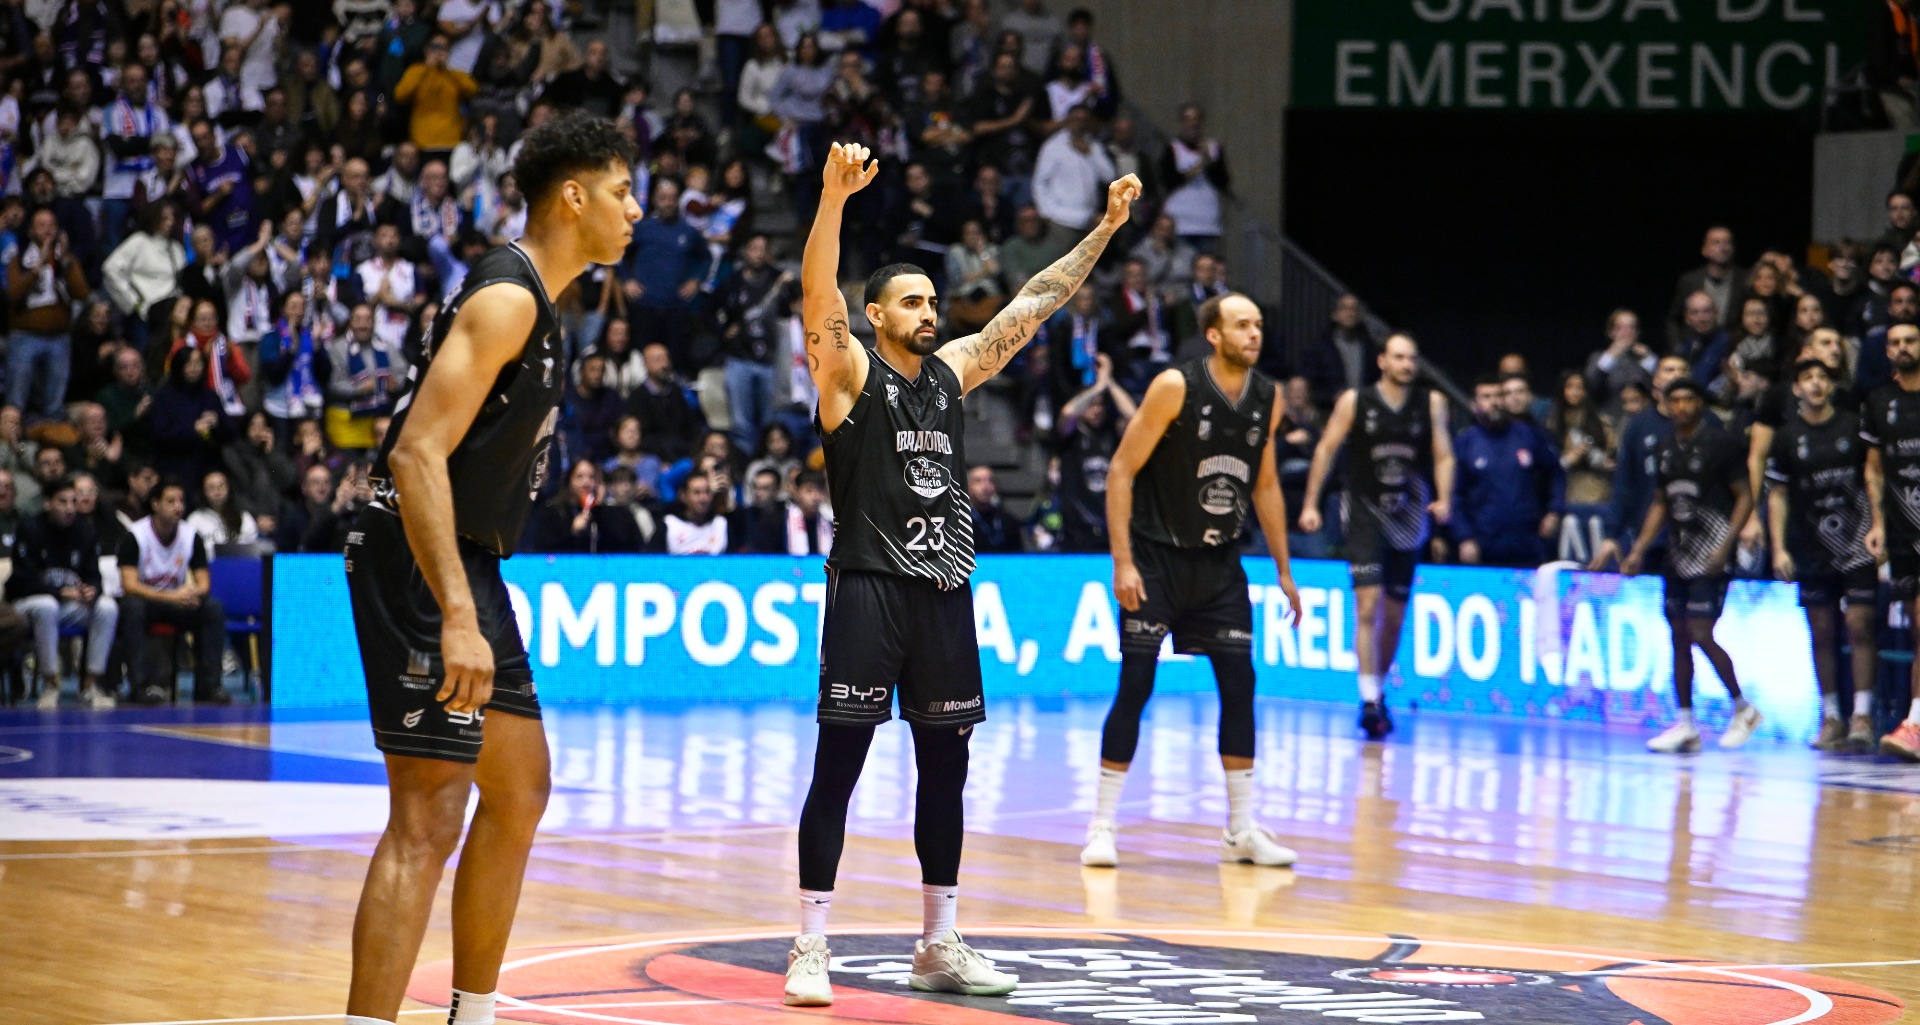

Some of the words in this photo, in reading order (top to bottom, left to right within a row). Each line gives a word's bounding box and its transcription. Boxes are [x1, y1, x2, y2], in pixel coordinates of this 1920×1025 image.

[1333, 41, 1846, 108] EMERXENCI
[978, 323, 1030, 371] First
[910, 465, 942, 479] Estrella
[913, 475, 943, 488] Galicia
[906, 516, 946, 551] 23
[1413, 593, 1500, 681] DO
[830, 683, 887, 701] BYD
